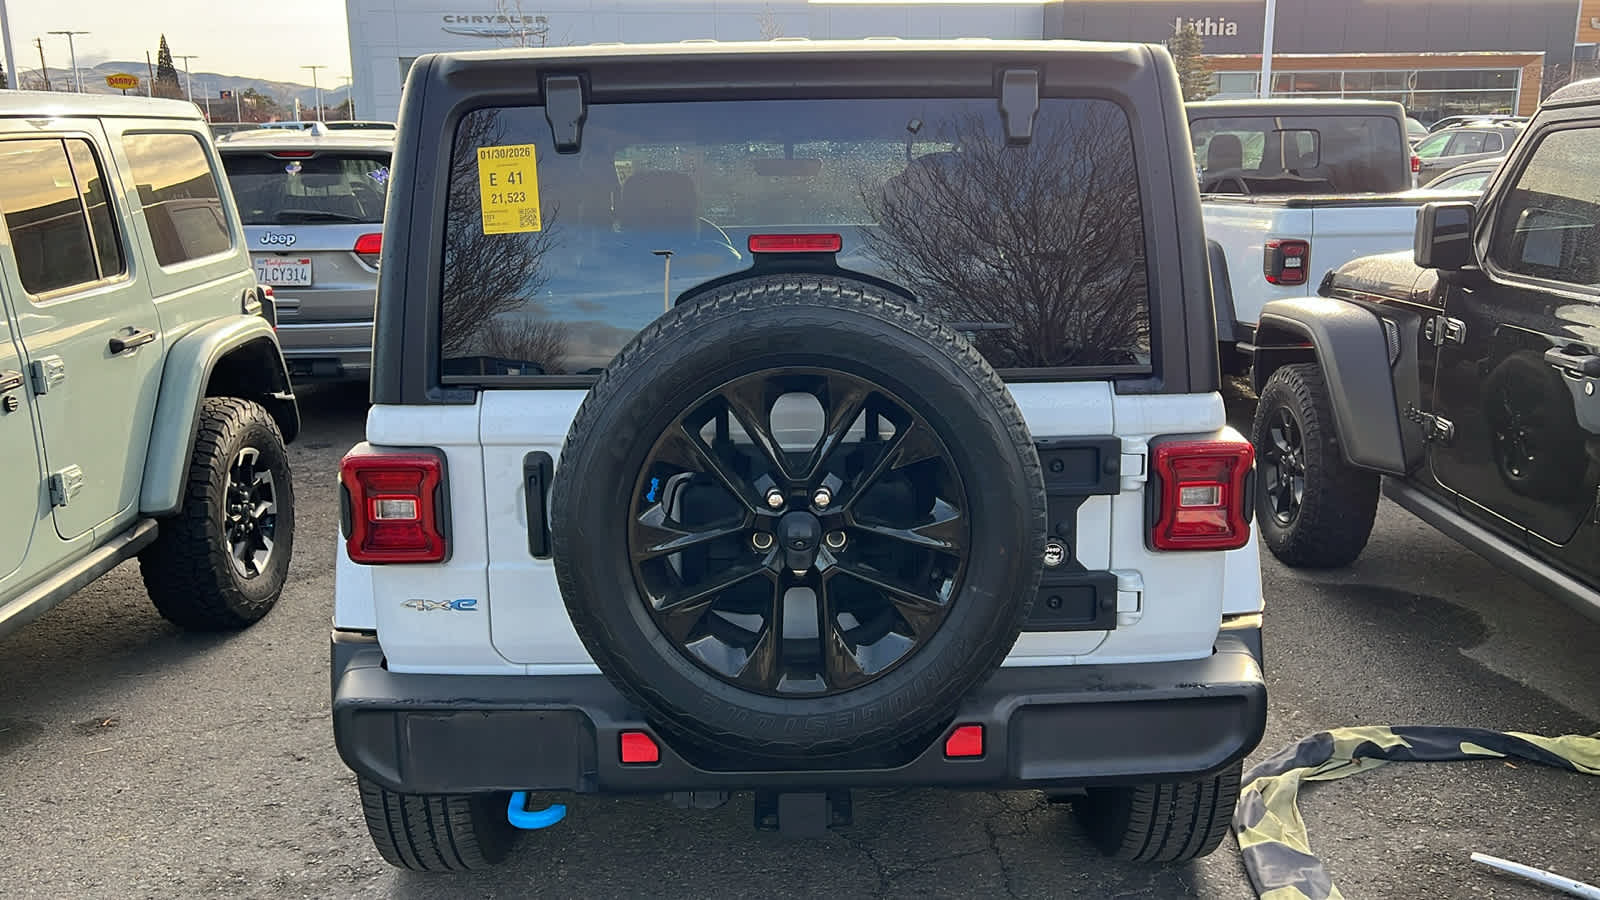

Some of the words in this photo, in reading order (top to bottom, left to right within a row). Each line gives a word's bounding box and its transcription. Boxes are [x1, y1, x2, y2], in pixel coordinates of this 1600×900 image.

[443, 15, 547, 24] CHRYSLER
[1175, 17, 1238, 36] Lithia
[480, 147, 530, 160] 01/30/2026
[489, 172, 498, 186] E
[508, 171, 522, 184] 41
[491, 191, 526, 204] 21,523
[260, 232, 296, 246] Jeep
[257, 267, 307, 281] 7LCY314
